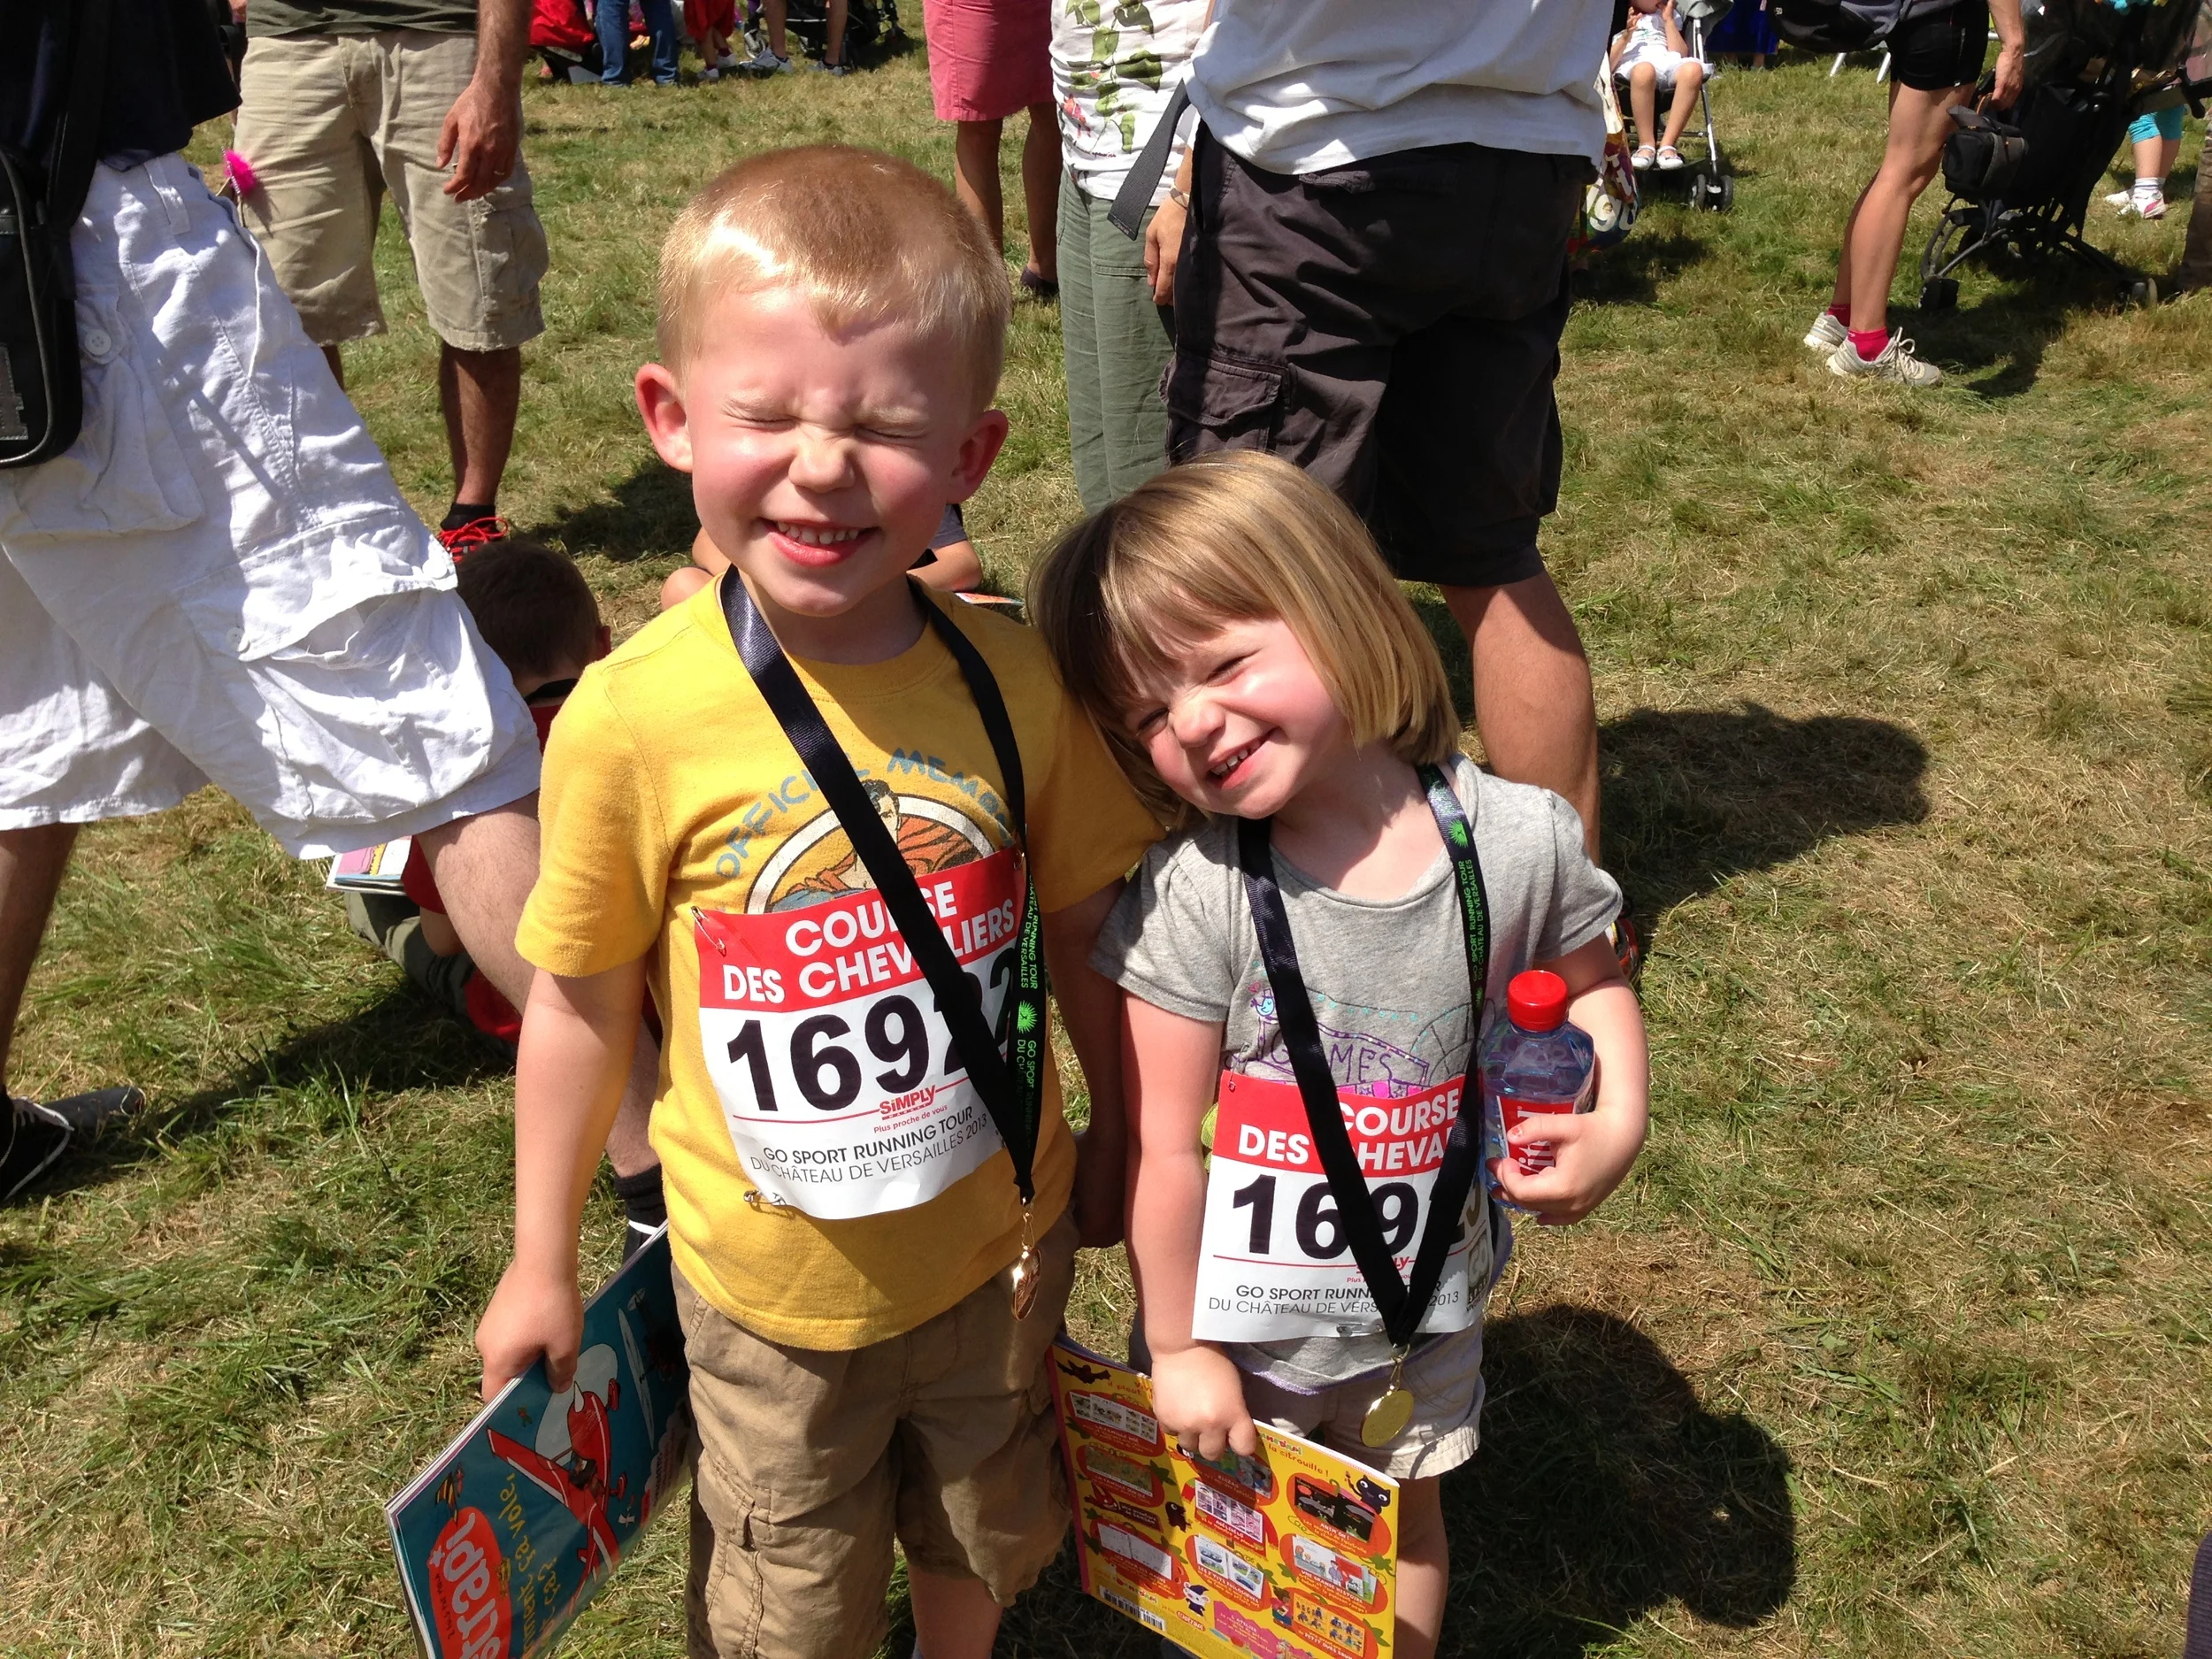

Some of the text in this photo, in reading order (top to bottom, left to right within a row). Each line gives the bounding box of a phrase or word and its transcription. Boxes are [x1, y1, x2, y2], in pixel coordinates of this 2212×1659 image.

[715, 752, 870, 879] OFFICIL
[1458, 860, 1469, 885] TOUR
[1465, 859, 1480, 907] VERSAILLES
[785, 881, 957, 956] COUSE
[1463, 887, 1476, 931] RUNNING
[722, 898, 1014, 1004] DES CHEVLIERS
[1028, 915, 1039, 961] RUNNING
[1020, 936, 1029, 988] VERSAILLES
[1029, 963, 1039, 990] TOUR
[1017, 1039, 1026, 1054] DU
[1027, 1040, 1037, 1058] GO
[1025, 1060, 1036, 1088] SPORT
[763, 1147, 788, 1164] GO
[793, 1148, 848, 1164] SPORT
[855, 1125, 936, 1163] RUNNING
[938, 1105, 973, 1133] TOUR
[873, 1125, 891, 1133] Plus
[893, 1116, 920, 1130] proche
[932, 1104, 948, 1115] vous
[750, 1113, 987, 1184] DU CHÂTEAU DE VERSAILLES 2013
[1238, 1124, 1452, 1171] DES HEVA
[1209, 1297, 1231, 1310] DU
[1236, 1301, 1311, 1315] CHÂTEAU
[1317, 1302, 1337, 1314] DE
[1429, 1290, 1460, 1307] 2013
[1236, 1285, 1264, 1299] GO
[1269, 1287, 1321, 1301] SPORT
[1325, 1287, 1372, 1301] RUNN
[1268, 1443, 1277, 1453] la
[1279, 1448, 1323, 1475] citrouille
[1314, 1575, 1334, 1589] GRANDE
[1336, 1586, 1363, 1604] HISTOIRE
[1304, 1632, 1320, 1644] PETIT
[1322, 1641, 1336, 1653] OURS
